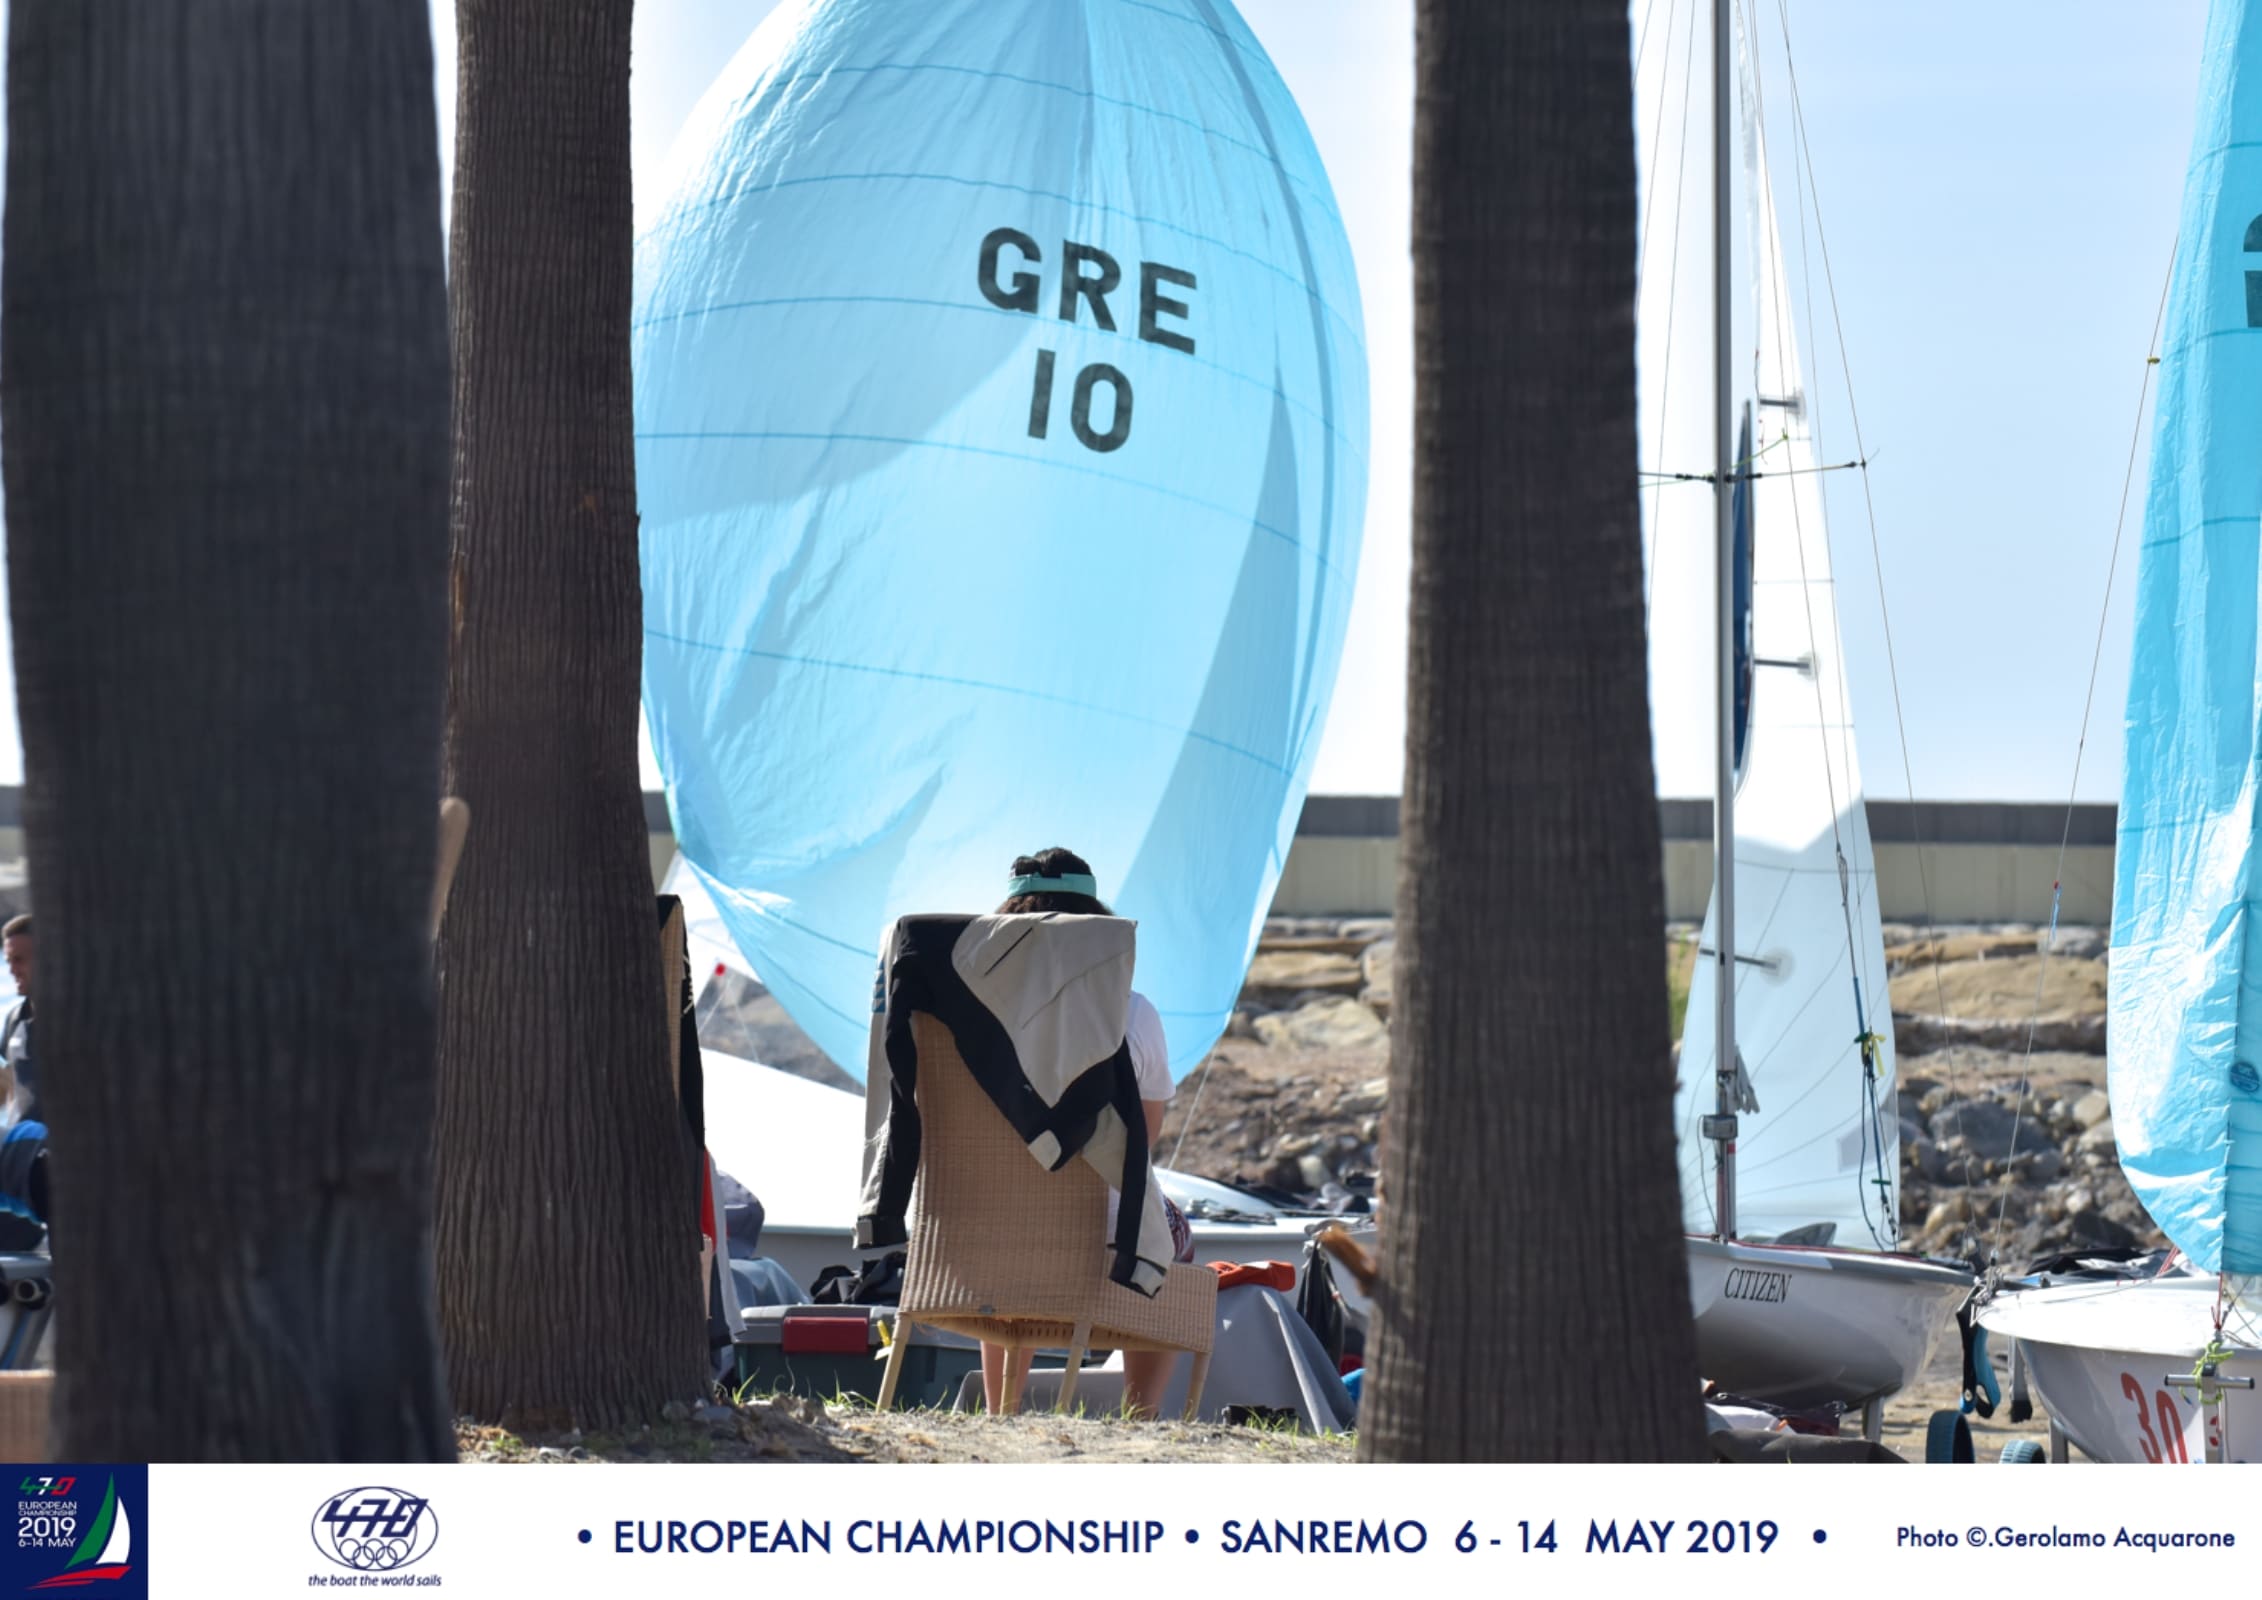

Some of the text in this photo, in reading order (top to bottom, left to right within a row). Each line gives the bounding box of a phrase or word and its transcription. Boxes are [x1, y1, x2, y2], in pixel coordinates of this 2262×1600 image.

[978, 227, 1197, 356] GRE
[1027, 348, 1134, 453] 10
[1724, 1267, 1792, 1304] CITIZEN
[2120, 1372, 2189, 1464] 30
